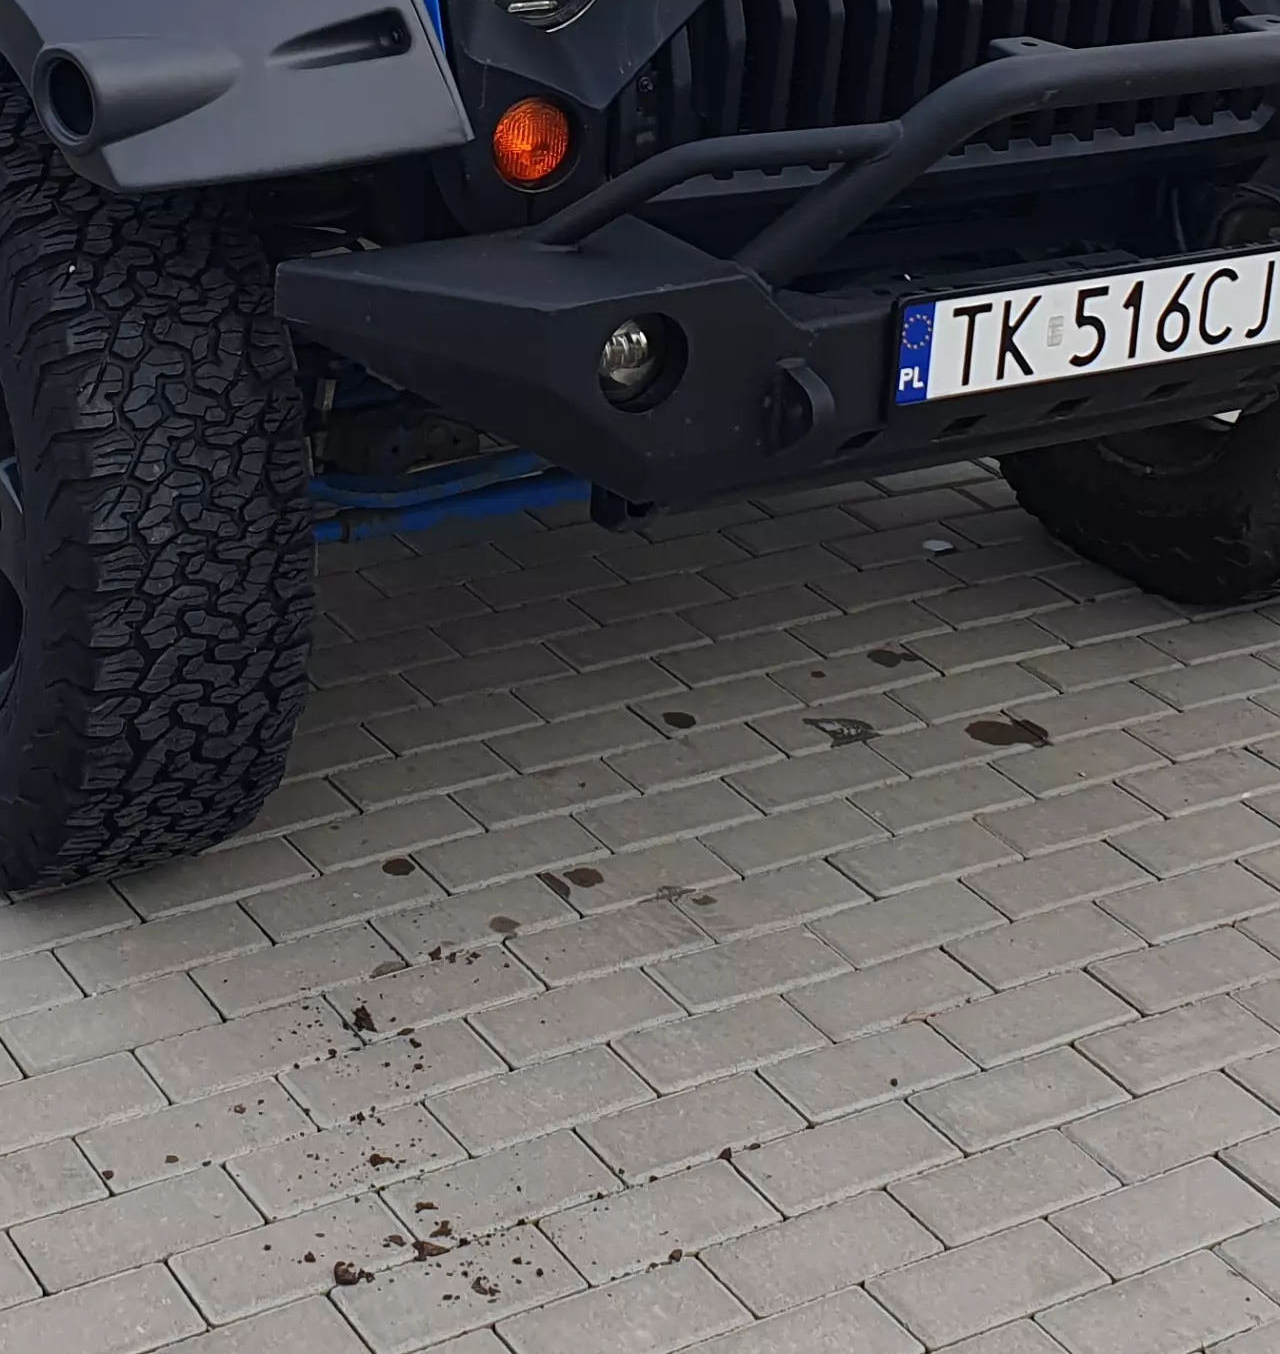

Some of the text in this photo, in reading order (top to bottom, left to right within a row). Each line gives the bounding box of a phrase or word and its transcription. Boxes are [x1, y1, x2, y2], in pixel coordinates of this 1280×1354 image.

[952, 260, 1276, 386] TK 516CJ
[898, 366, 924, 391] PL
